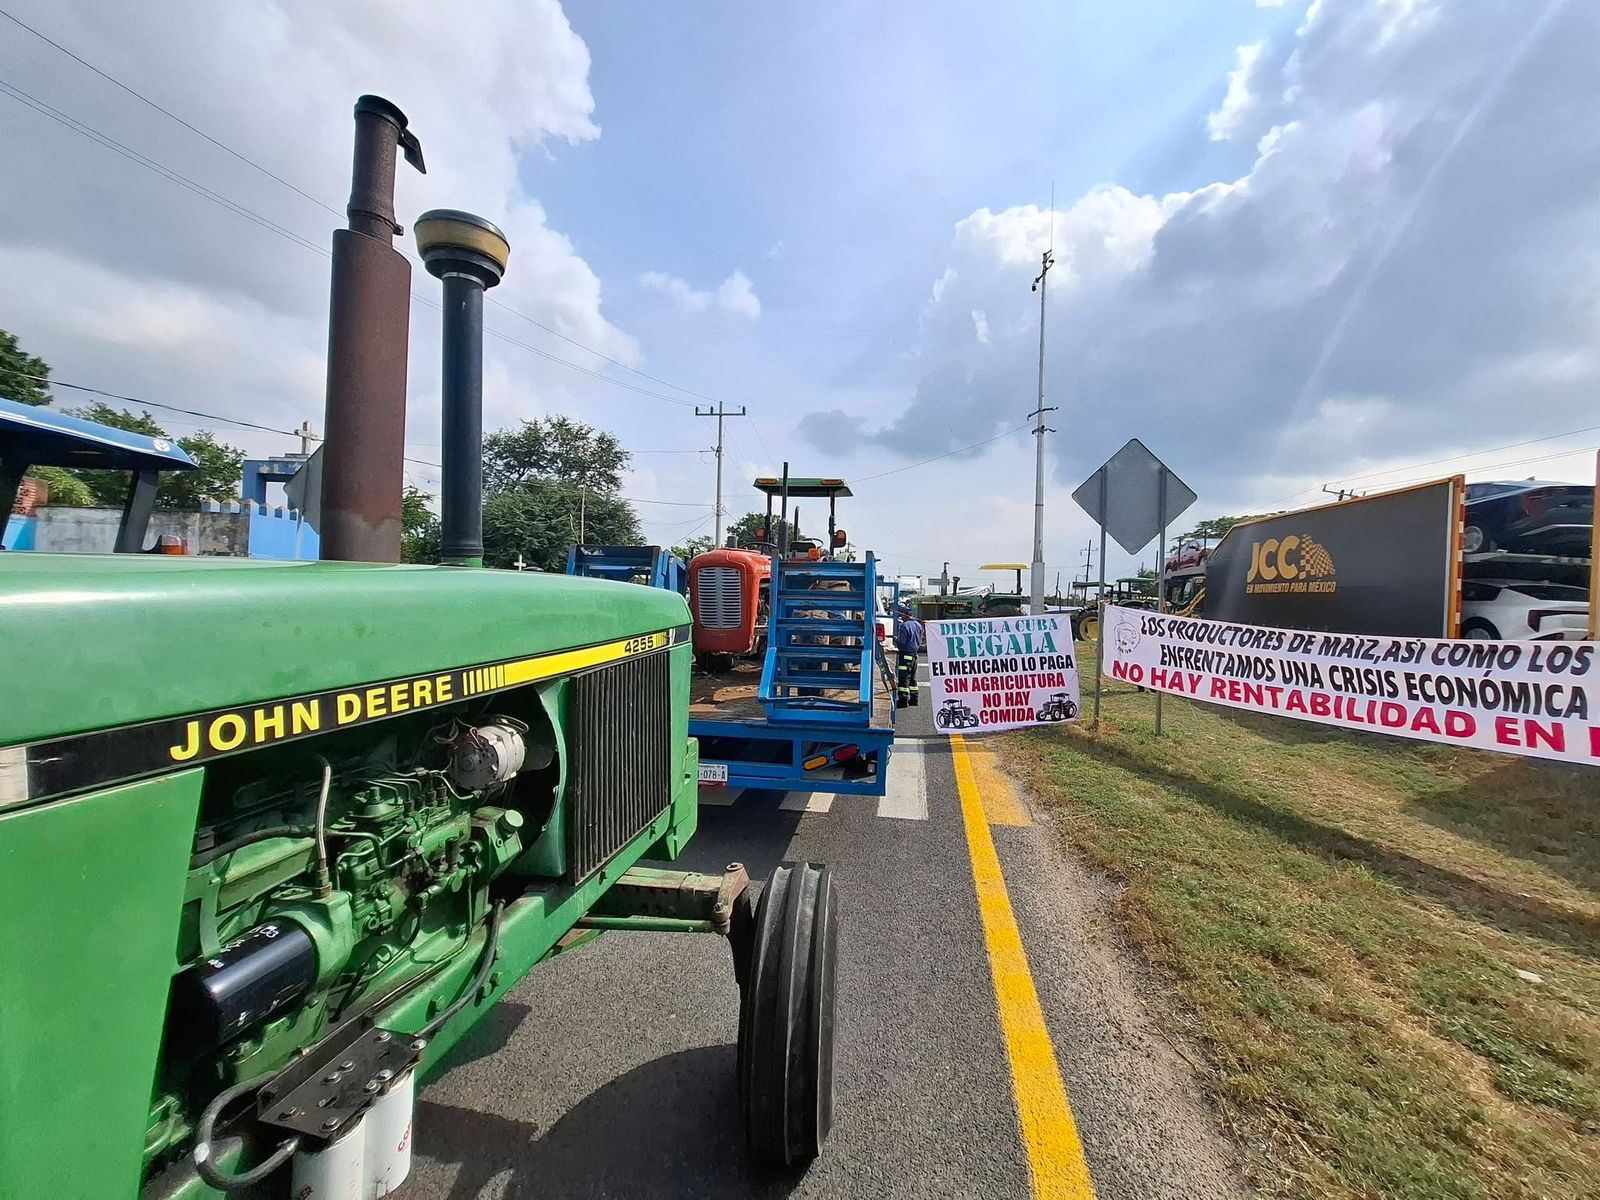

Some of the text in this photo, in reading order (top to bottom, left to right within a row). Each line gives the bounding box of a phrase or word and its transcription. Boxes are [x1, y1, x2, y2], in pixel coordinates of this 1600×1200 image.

[1247, 535, 1300, 583] JCC
[1254, 583, 1290, 593] MOVIMIENTO
[1290, 582, 1307, 592] PARA
[940, 618, 1058, 636] DIESEL A CUBA
[624, 636, 654, 654] 4255
[945, 632, 1058, 658] REGALA
[1140, 615, 1166, 637] LOS
[1167, 619, 1286, 651] PRODUCTORES
[1288, 632, 1316, 655] DE
[1430, 642, 1521, 670] COMO
[1527, 644, 1594, 676] LOS
[932, 655, 1074, 676] EL MEXICANO LO PAGA
[944, 672, 1065, 693] SIN AGRICULTURA
[1159, 643, 1276, 682] ENFRENTAMOS
[1279, 659, 1324, 689] UNA
[1328, 664, 1399, 698] CRISIS
[1404, 669, 1588, 720] ECONÓMICA
[982, 691, 1031, 708] NO HAY
[1112, 660, 1143, 683] NO
[1150, 666, 1203, 694] HAY
[1210, 677, 1476, 738] RENTABILIDAD
[1495, 715, 1566, 752] EN
[170, 675, 453, 761] JOHN DEERE
[979, 707, 1035, 725] COMIDA
